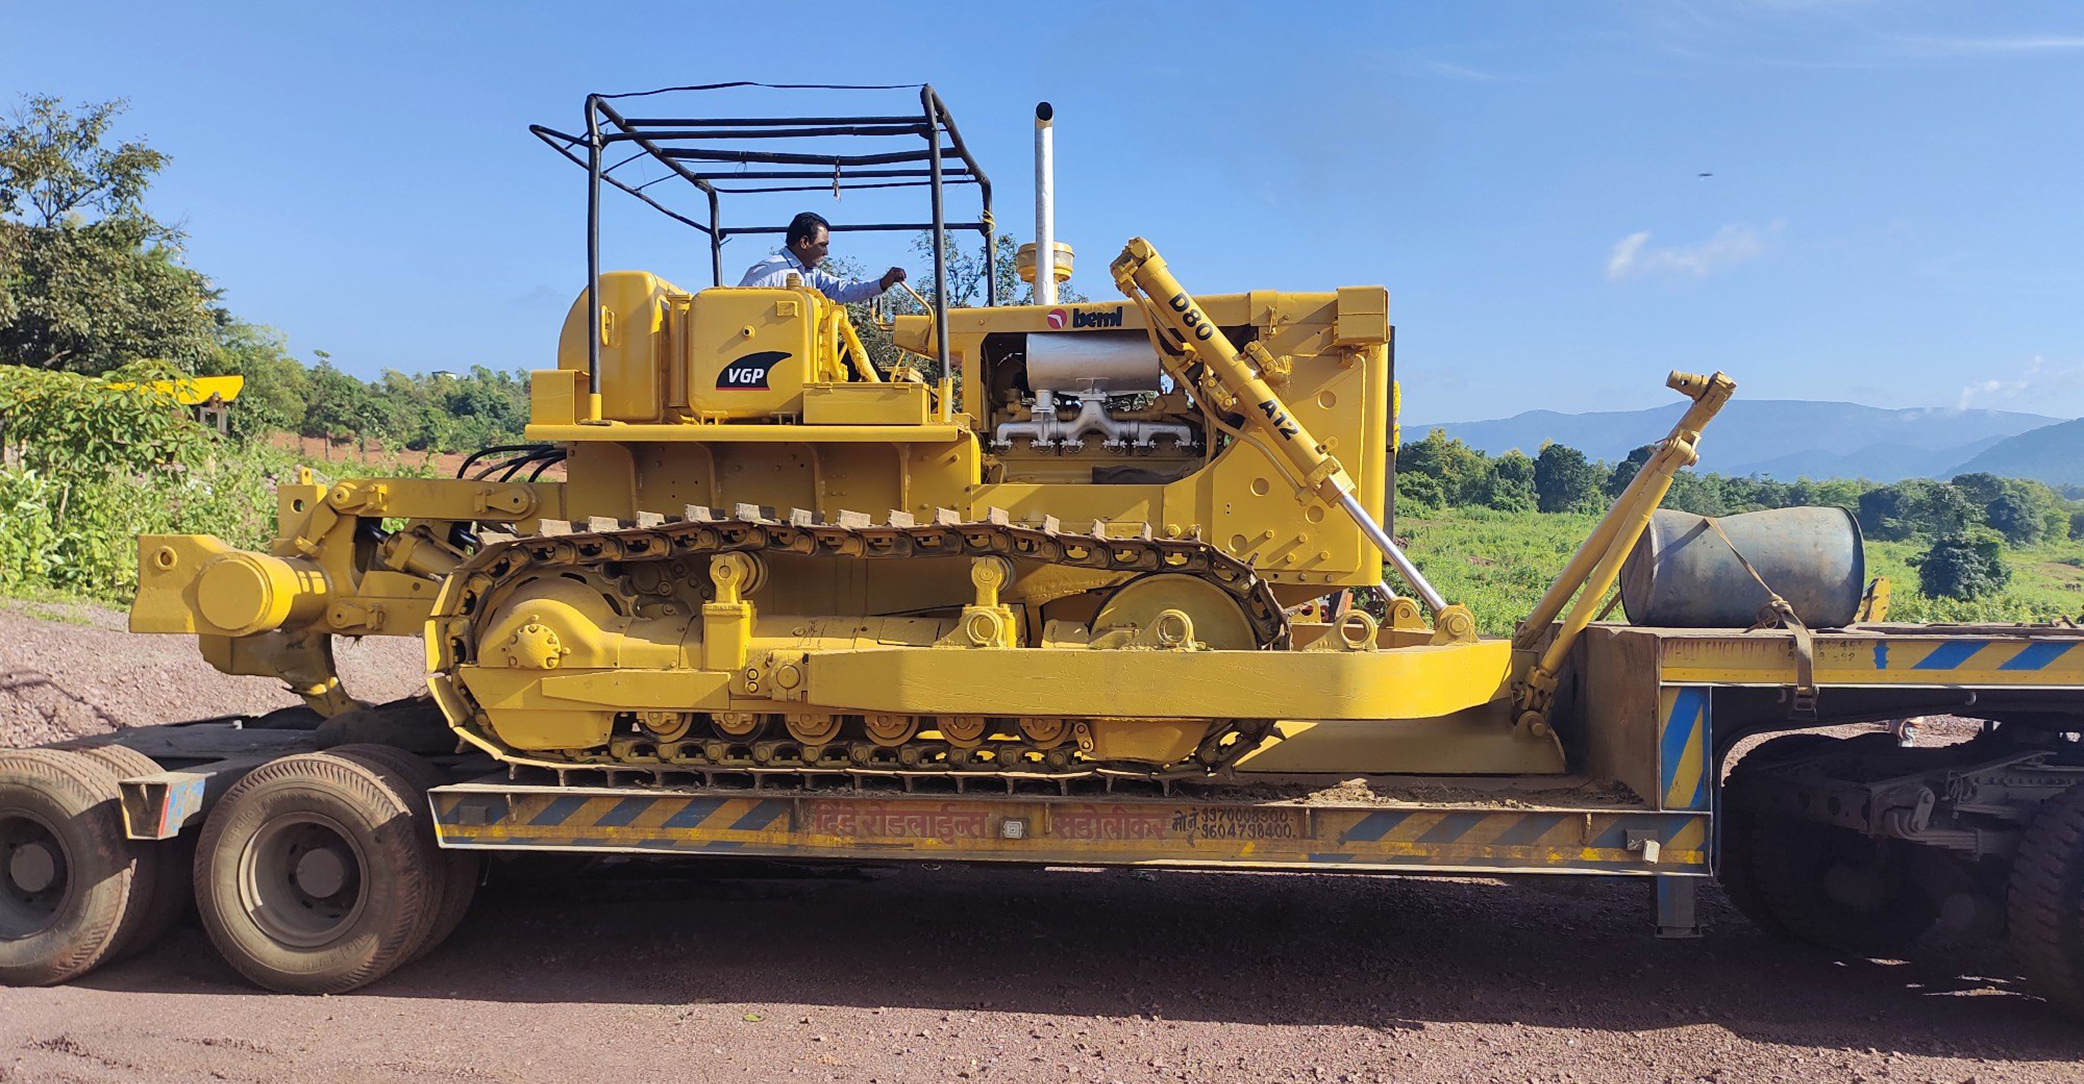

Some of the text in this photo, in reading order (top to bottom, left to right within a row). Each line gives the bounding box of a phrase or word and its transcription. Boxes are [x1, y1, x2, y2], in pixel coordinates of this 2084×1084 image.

[1072, 306, 1123, 328] beml
[728, 368, 765, 384] VGP
[1168, 292, 1300, 441] D80 A12
